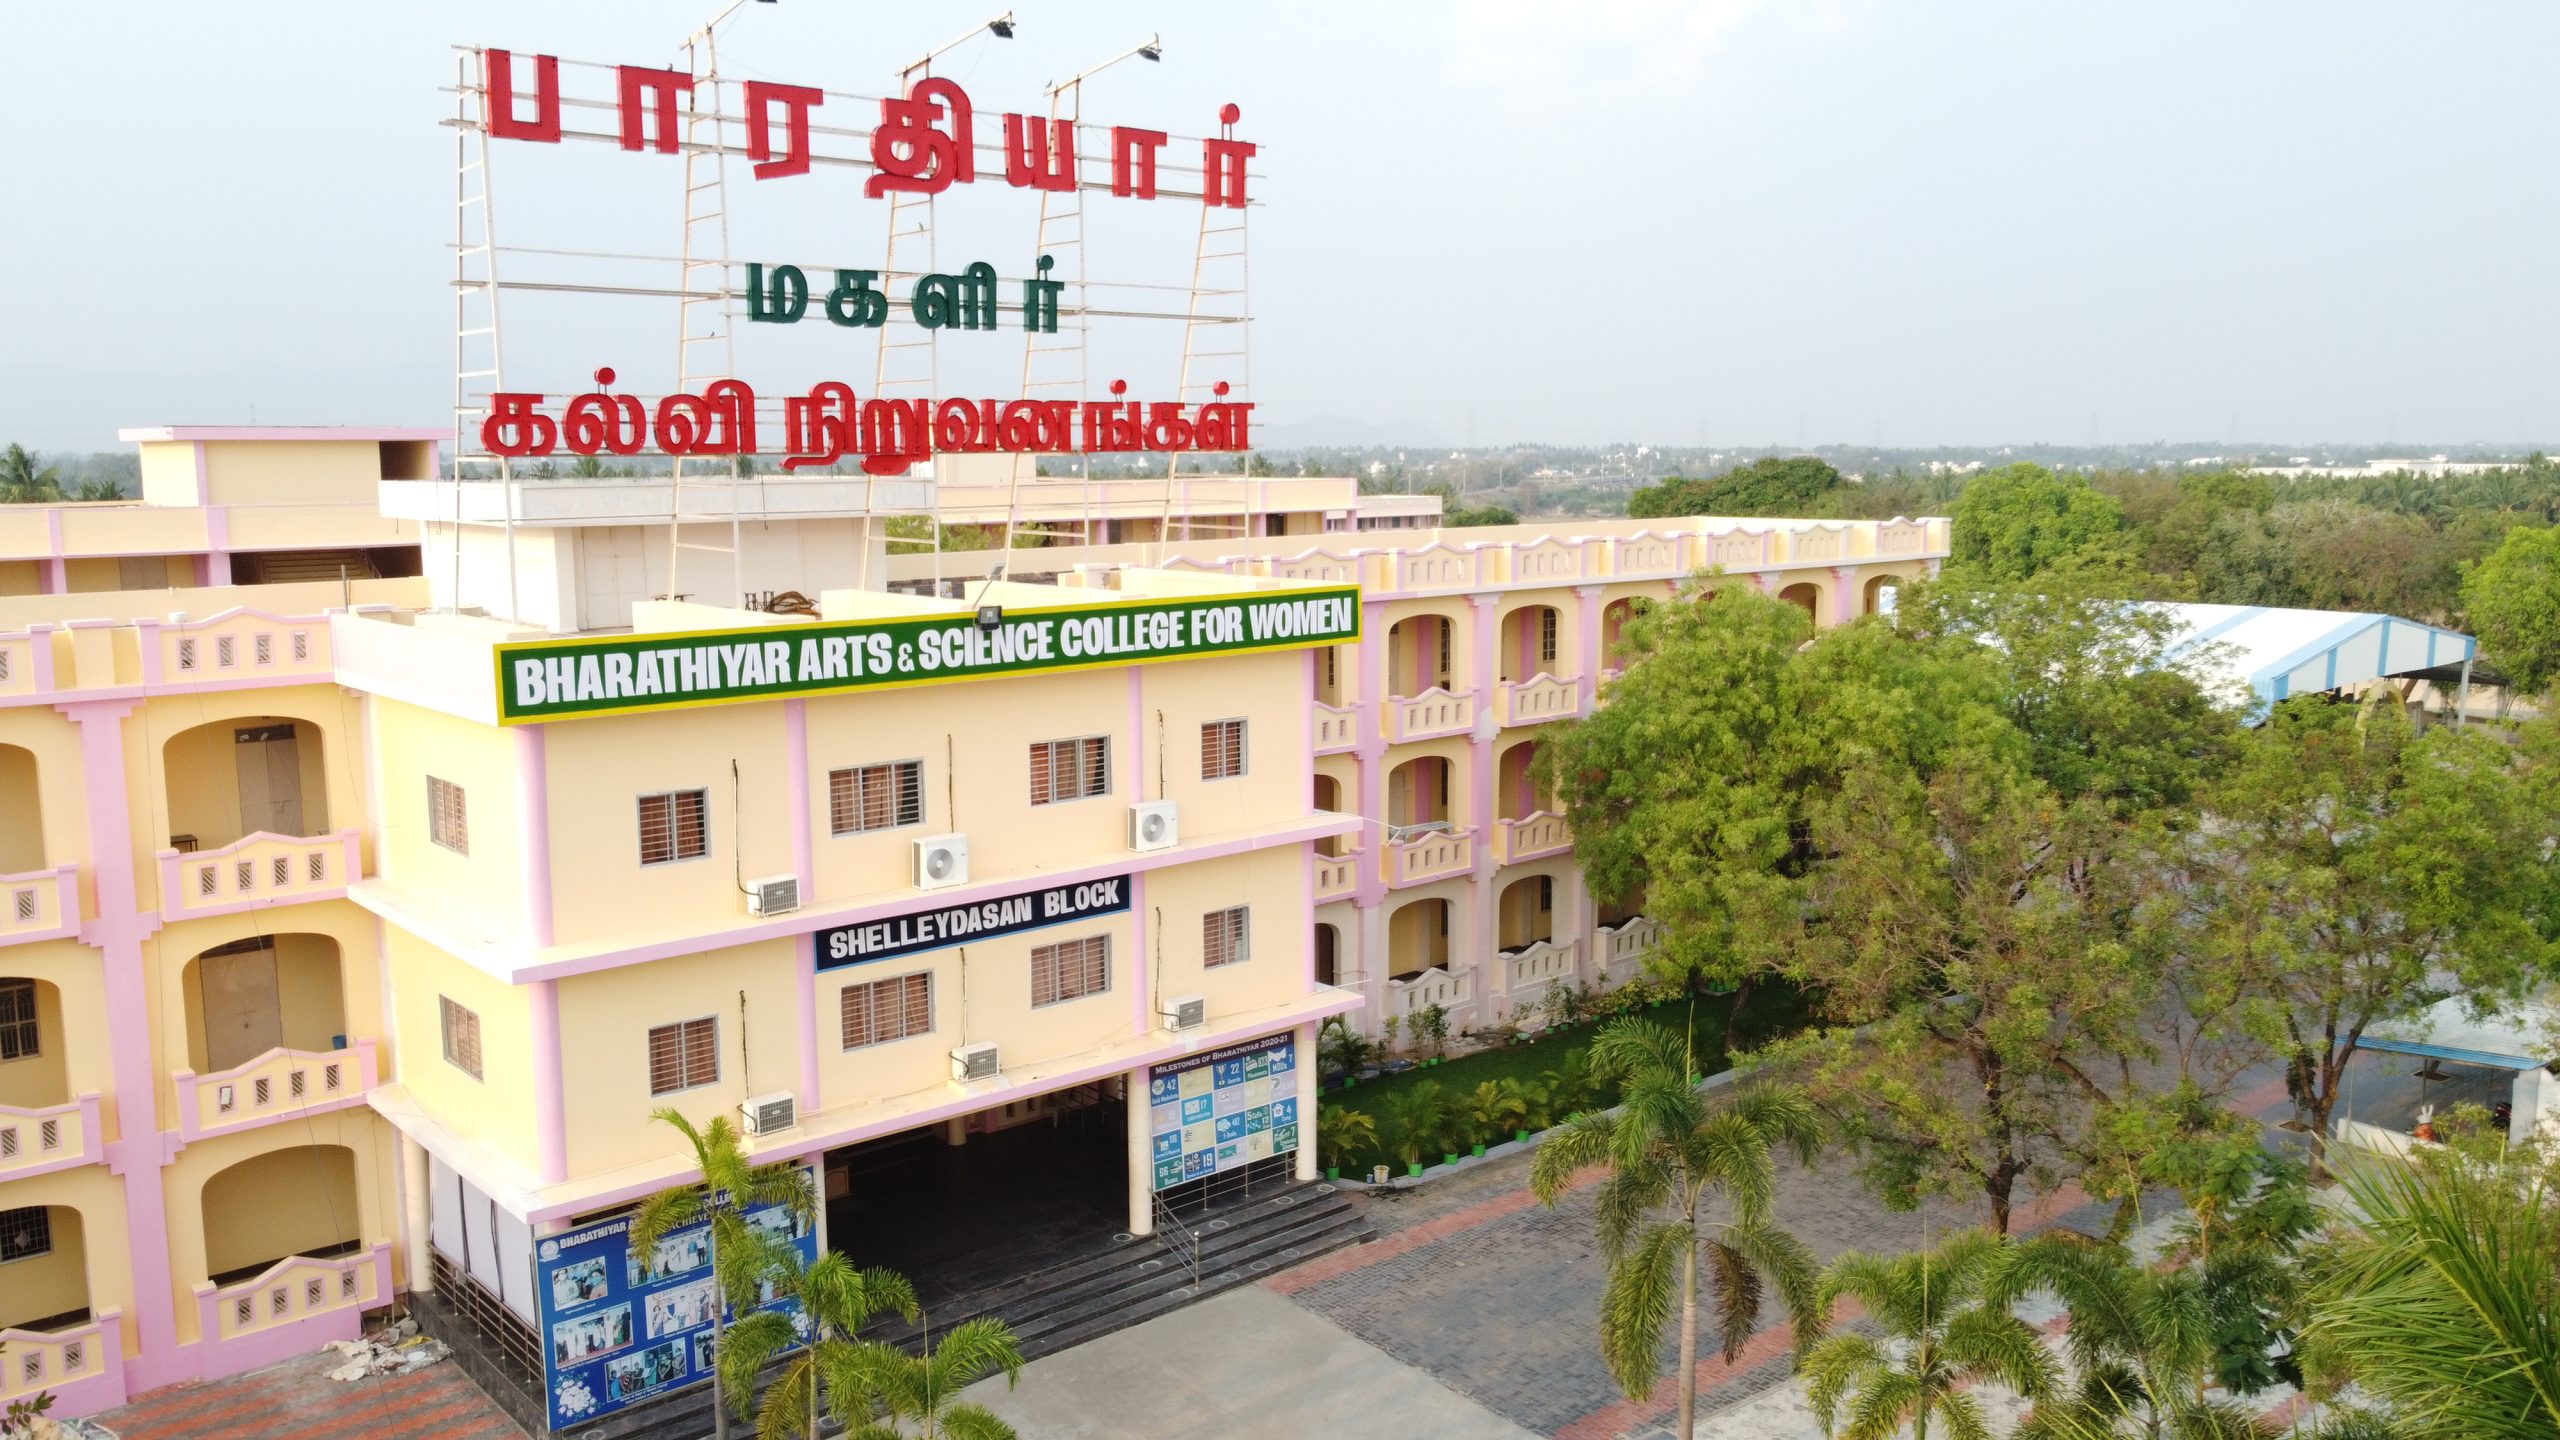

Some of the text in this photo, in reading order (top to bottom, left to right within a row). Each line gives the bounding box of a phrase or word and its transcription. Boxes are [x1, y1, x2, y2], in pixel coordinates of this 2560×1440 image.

[485, 49, 1256, 209] பாரதியார்
[745, 255, 1064, 333] மகளிர்
[480, 367, 1256, 476] கல்வி நிறுவனங்கள்
[514, 597, 1352, 707] BHARATHIYAR ARTS & SCIENCE COLLEGE FOR WOMEN
[829, 880, 1120, 959] SHELLEYDASAN BLOCK
[1155, 1035, 1288, 1075] MILESTONES OF BHARATHIYAR 2020-21
[1230, 1063, 1240, 1075] 22
[1166, 1079, 1176, 1091] 42
[1202, 1153, 1213, 1168] 19
[559, 1221, 627, 1250] BHARATHIYAR
